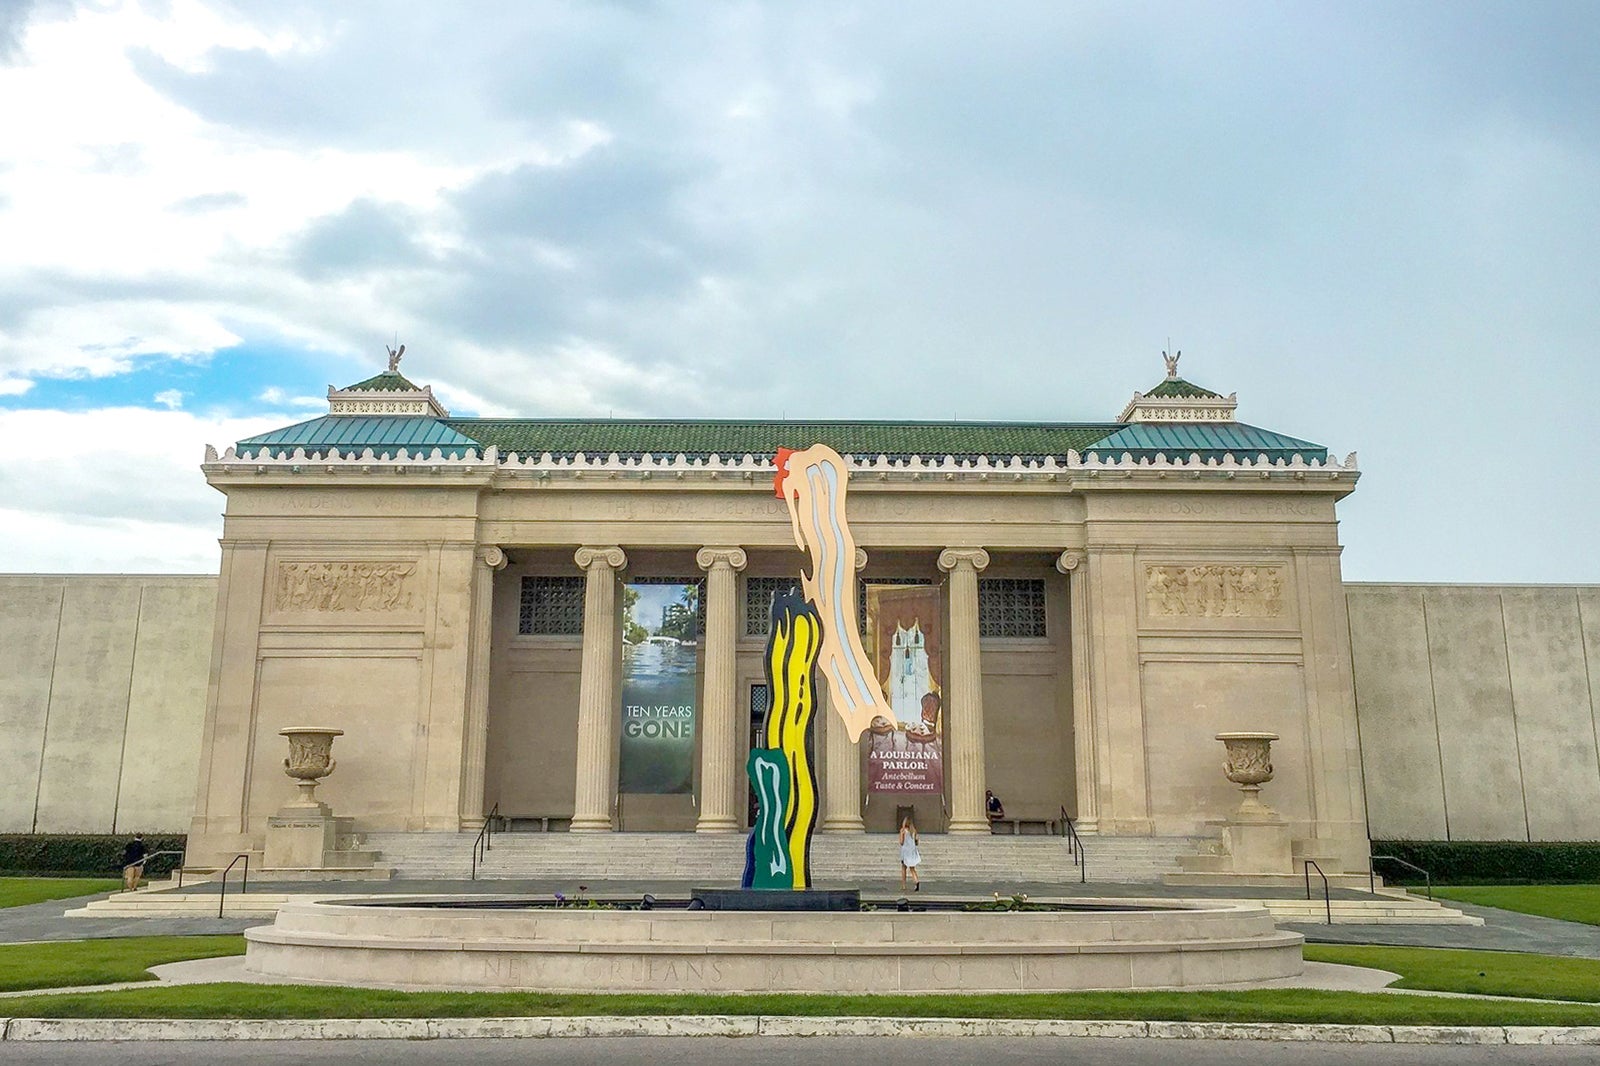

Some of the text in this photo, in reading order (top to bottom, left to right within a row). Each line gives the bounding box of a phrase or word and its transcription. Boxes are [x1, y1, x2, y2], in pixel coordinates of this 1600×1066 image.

[626, 705, 692, 717] TEN YEARS
[624, 720, 691, 738] GONE
[870, 751, 938, 759] A LOUISIANA
[882, 761, 928, 770] PARLOR:
[882, 772, 926, 780] Antebellum
[875, 782, 935, 790] Taste & Context
[583, 959, 723, 983] ORLEANS
